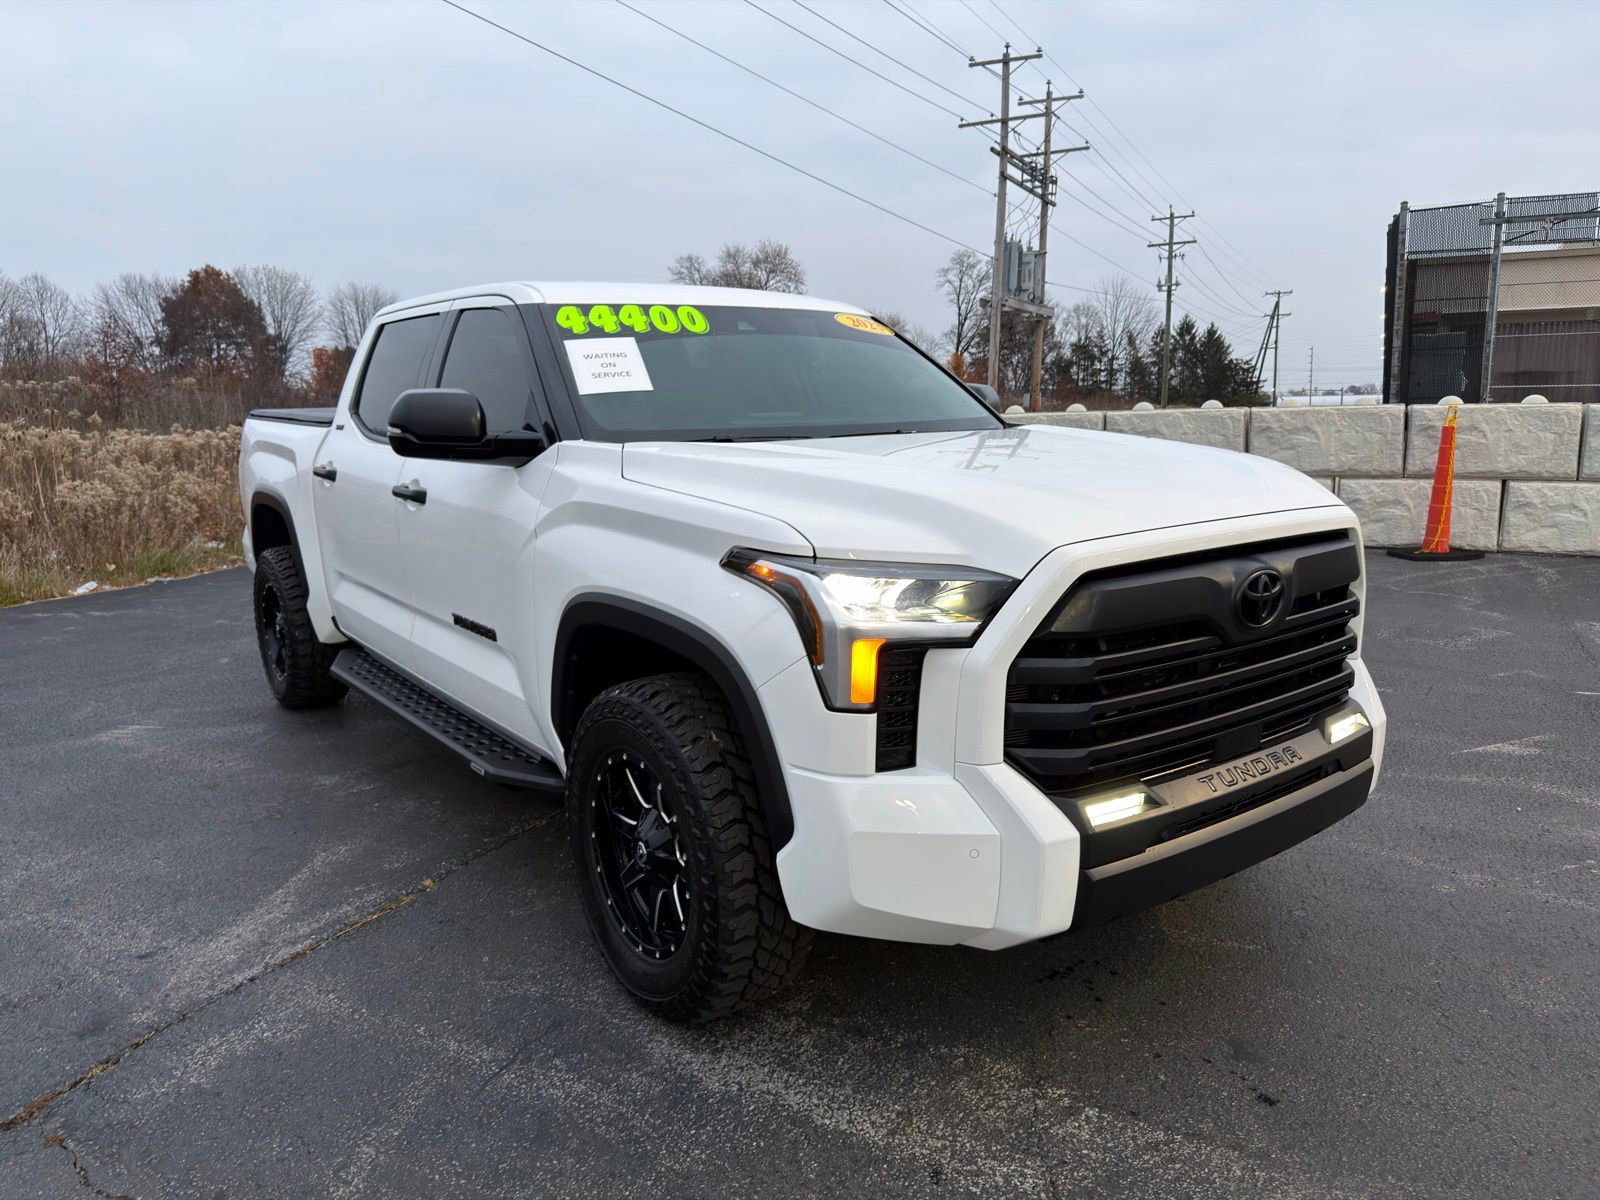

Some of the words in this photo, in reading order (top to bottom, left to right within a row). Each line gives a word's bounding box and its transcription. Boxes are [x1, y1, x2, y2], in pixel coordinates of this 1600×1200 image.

[555, 304, 710, 334] 44400
[582, 352, 628, 360] WAITING
[591, 370, 633, 379] SERVICE
[1197, 746, 1303, 793] TUNDRA
